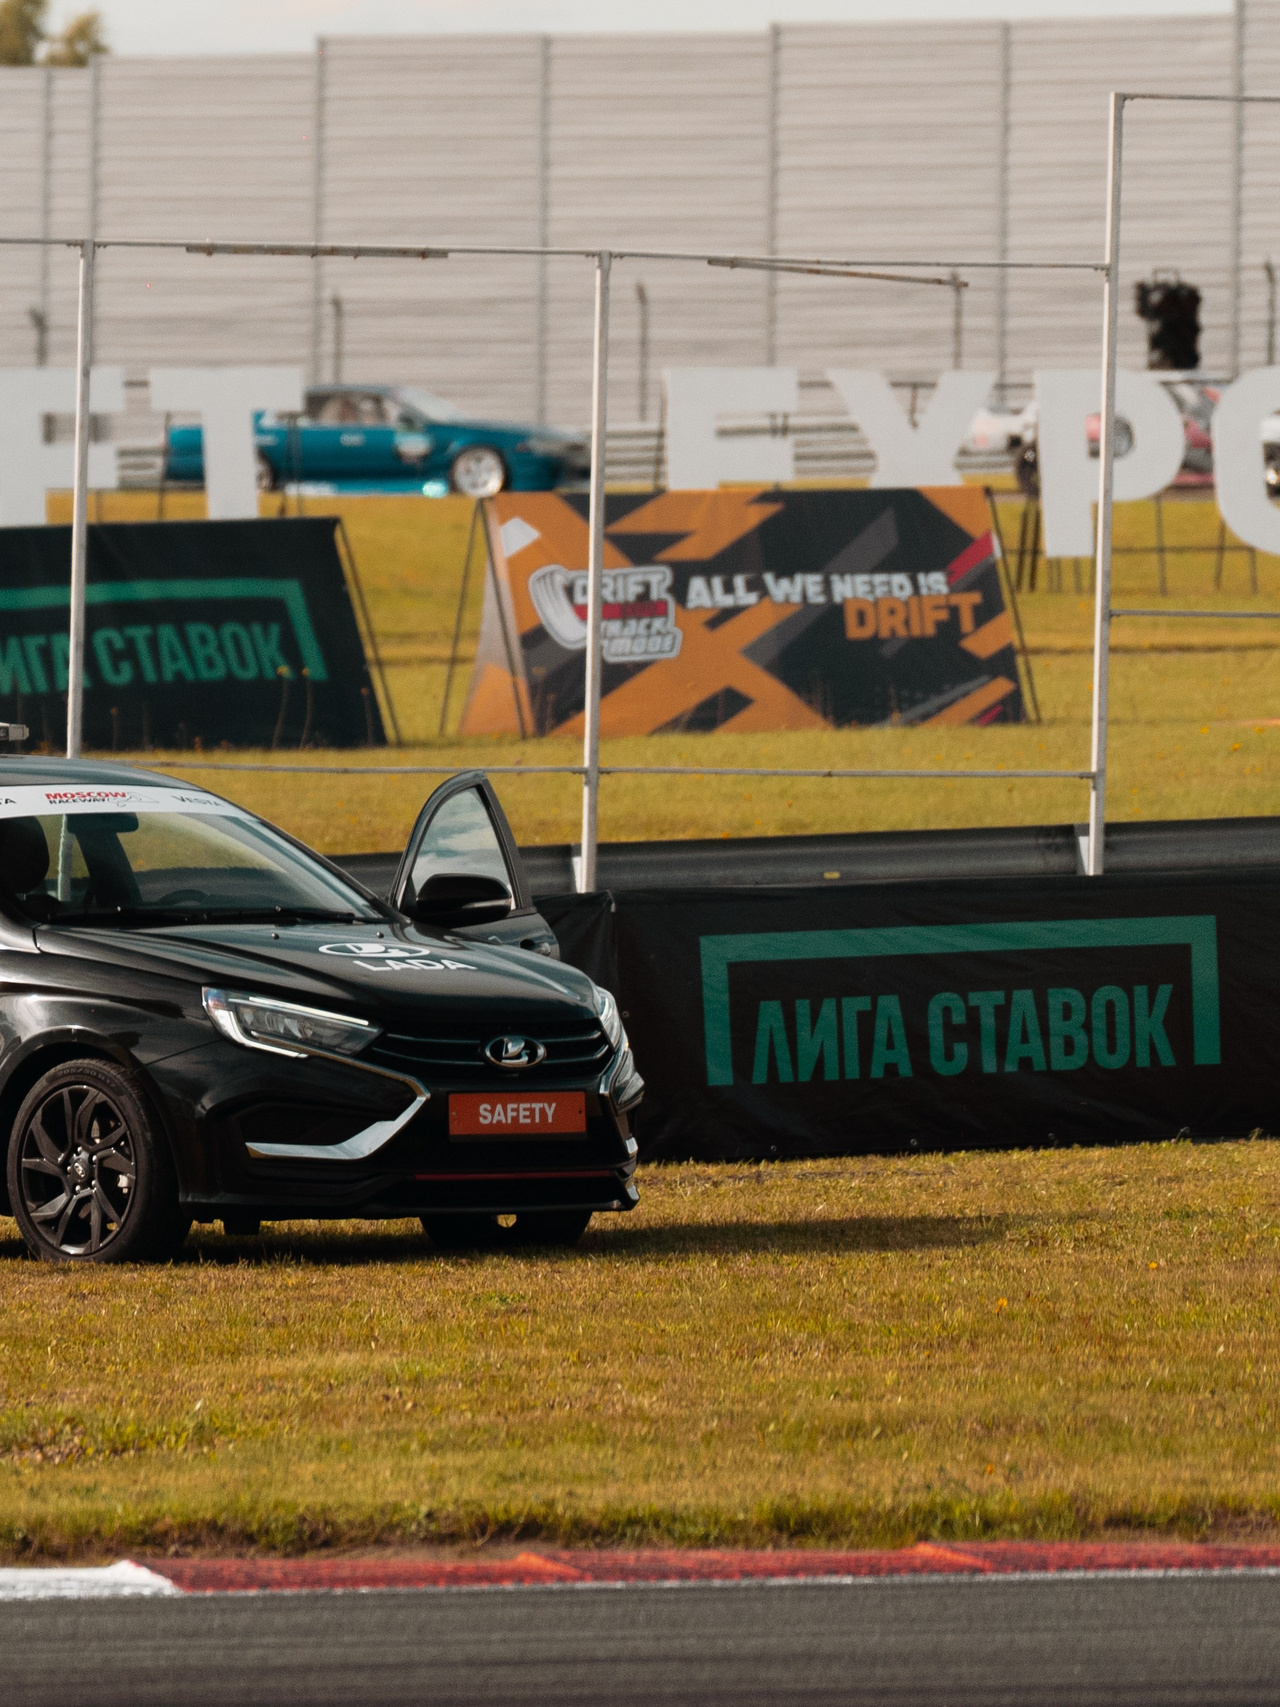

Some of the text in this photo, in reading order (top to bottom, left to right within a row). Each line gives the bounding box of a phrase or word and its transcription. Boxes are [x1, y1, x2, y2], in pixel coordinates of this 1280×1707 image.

[686, 574, 760, 610] ALL
[762, 571, 827, 605] WE
[830, 571, 913, 603] NEED
[917, 570, 950, 596] IS
[843, 591, 982, 641] DRIFT
[93, 622, 295, 687] СТАВОК
[44, 791, 127, 800] MOSCOW
[352, 959, 478, 972] LADA
[751, 983, 1176, 1085] ЛИГА СТАВОК
[478, 1102, 557, 1124] SAFETY
